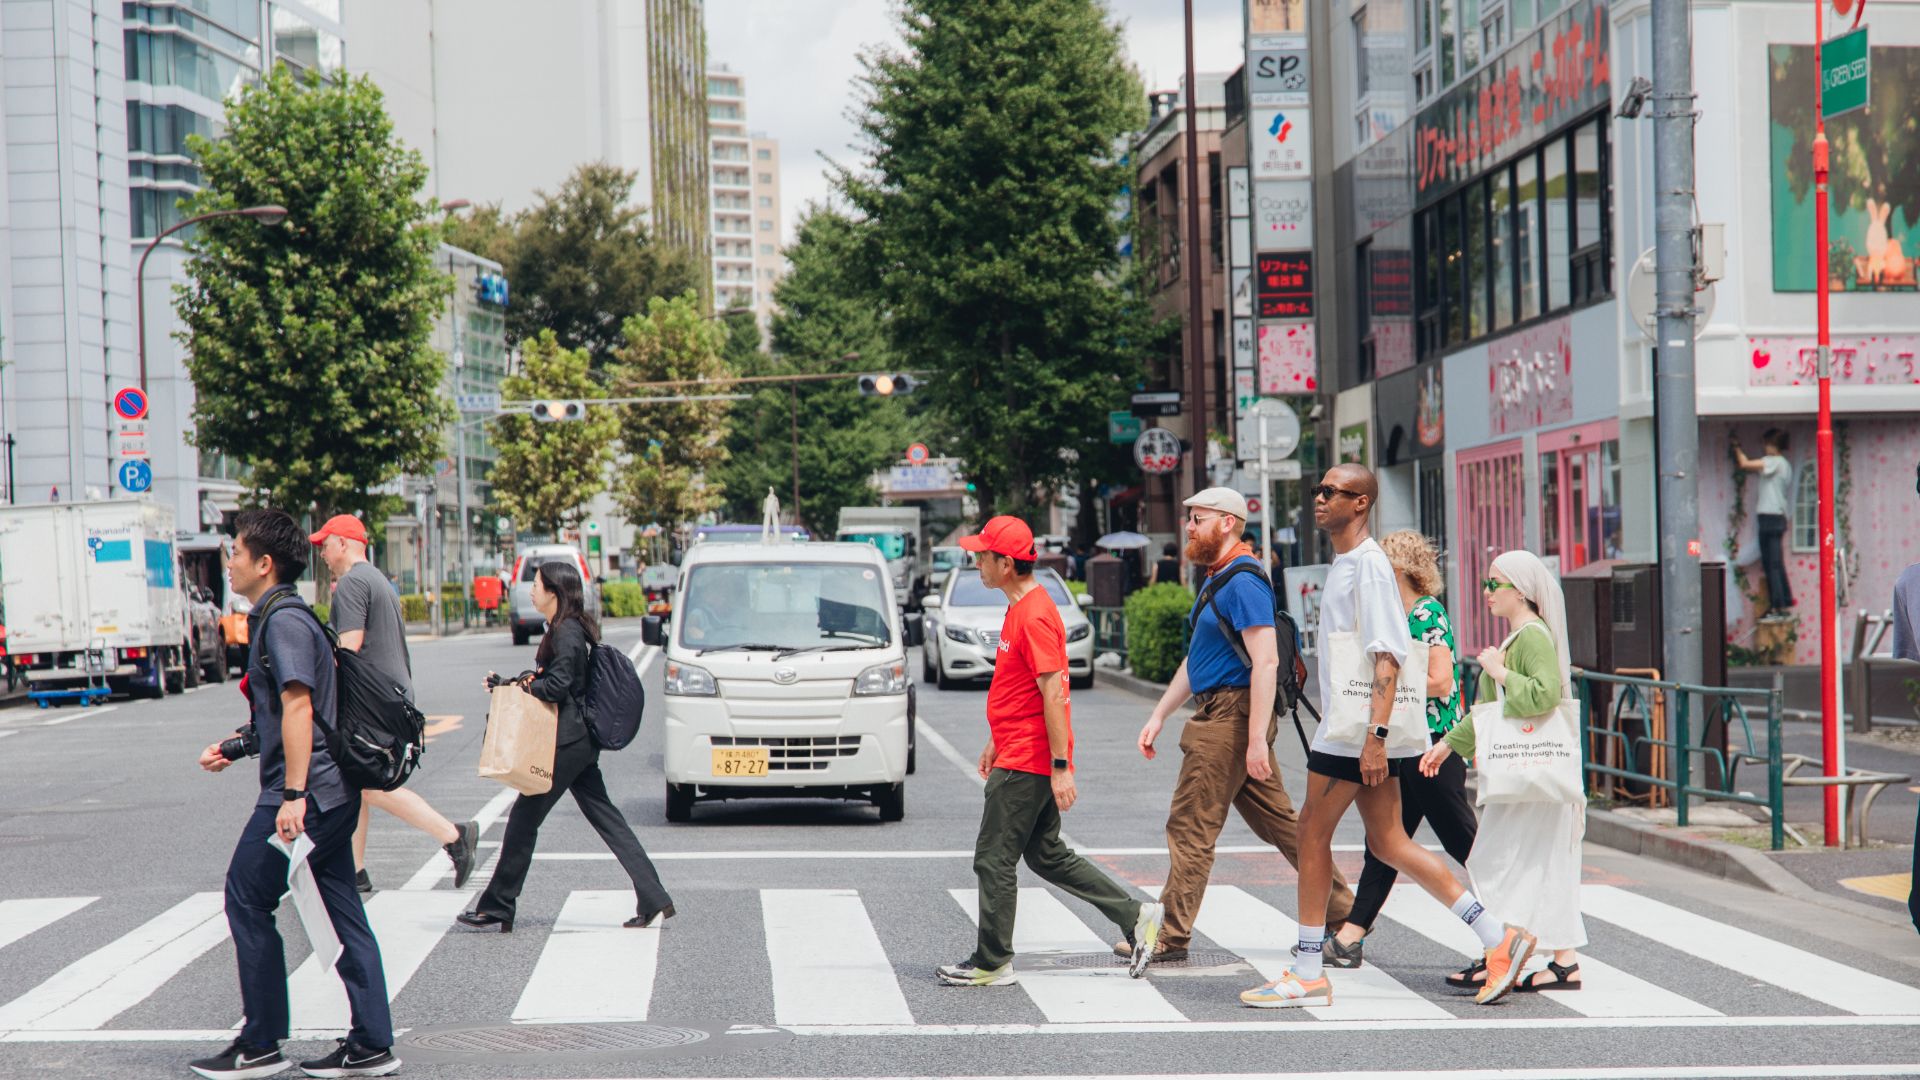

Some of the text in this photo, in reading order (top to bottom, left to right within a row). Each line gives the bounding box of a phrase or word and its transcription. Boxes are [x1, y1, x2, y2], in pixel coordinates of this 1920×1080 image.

[1256, 55, 1300, 78] SP
[1260, 259, 1310, 273] リフォーム
[125, 466, 139, 488] P
[1396, 685, 1417, 694] sitive
[1493, 740, 1564, 750] Creating positive
[1488, 751, 1520, 760] change
[1521, 750, 1555, 759] through
[724, 760, 765, 774] 87-27
